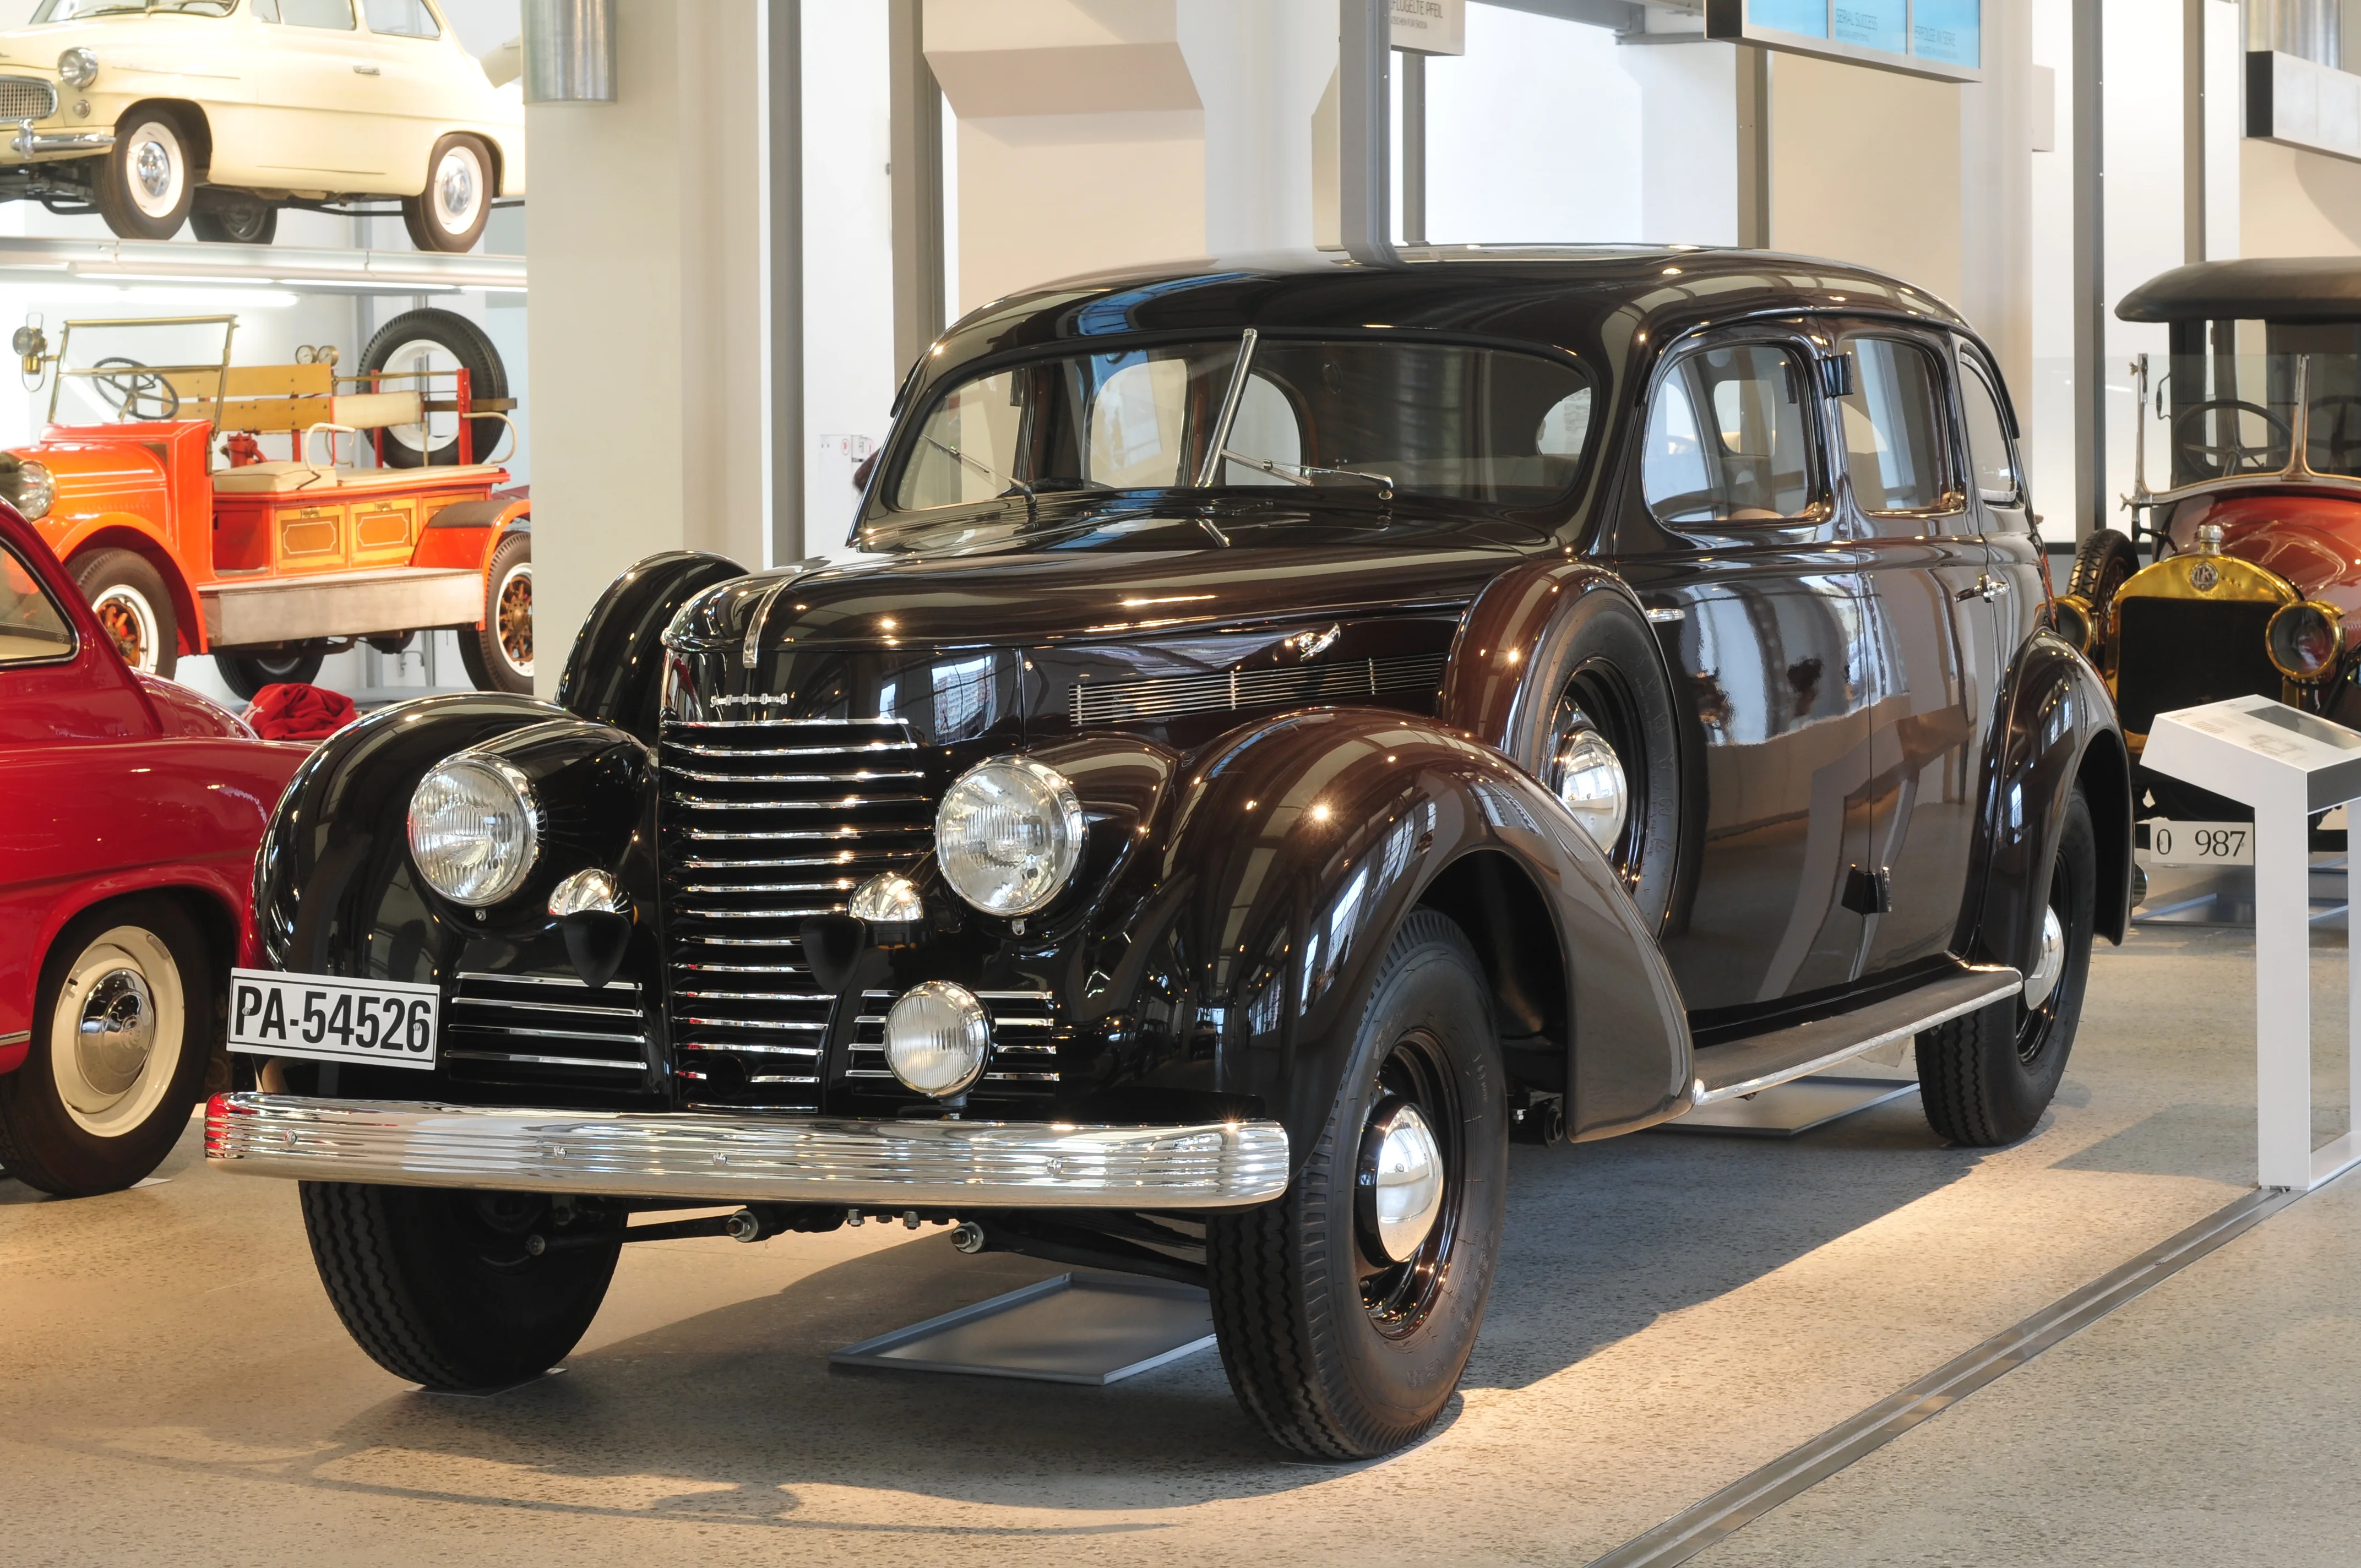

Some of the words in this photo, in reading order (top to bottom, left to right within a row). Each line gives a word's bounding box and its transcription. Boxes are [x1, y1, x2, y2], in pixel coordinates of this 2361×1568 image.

[1426, 2, 1443, 18] PFEIL
[2195, 830, 2246, 857] 987
[235, 985, 431, 1053] PA-54526
